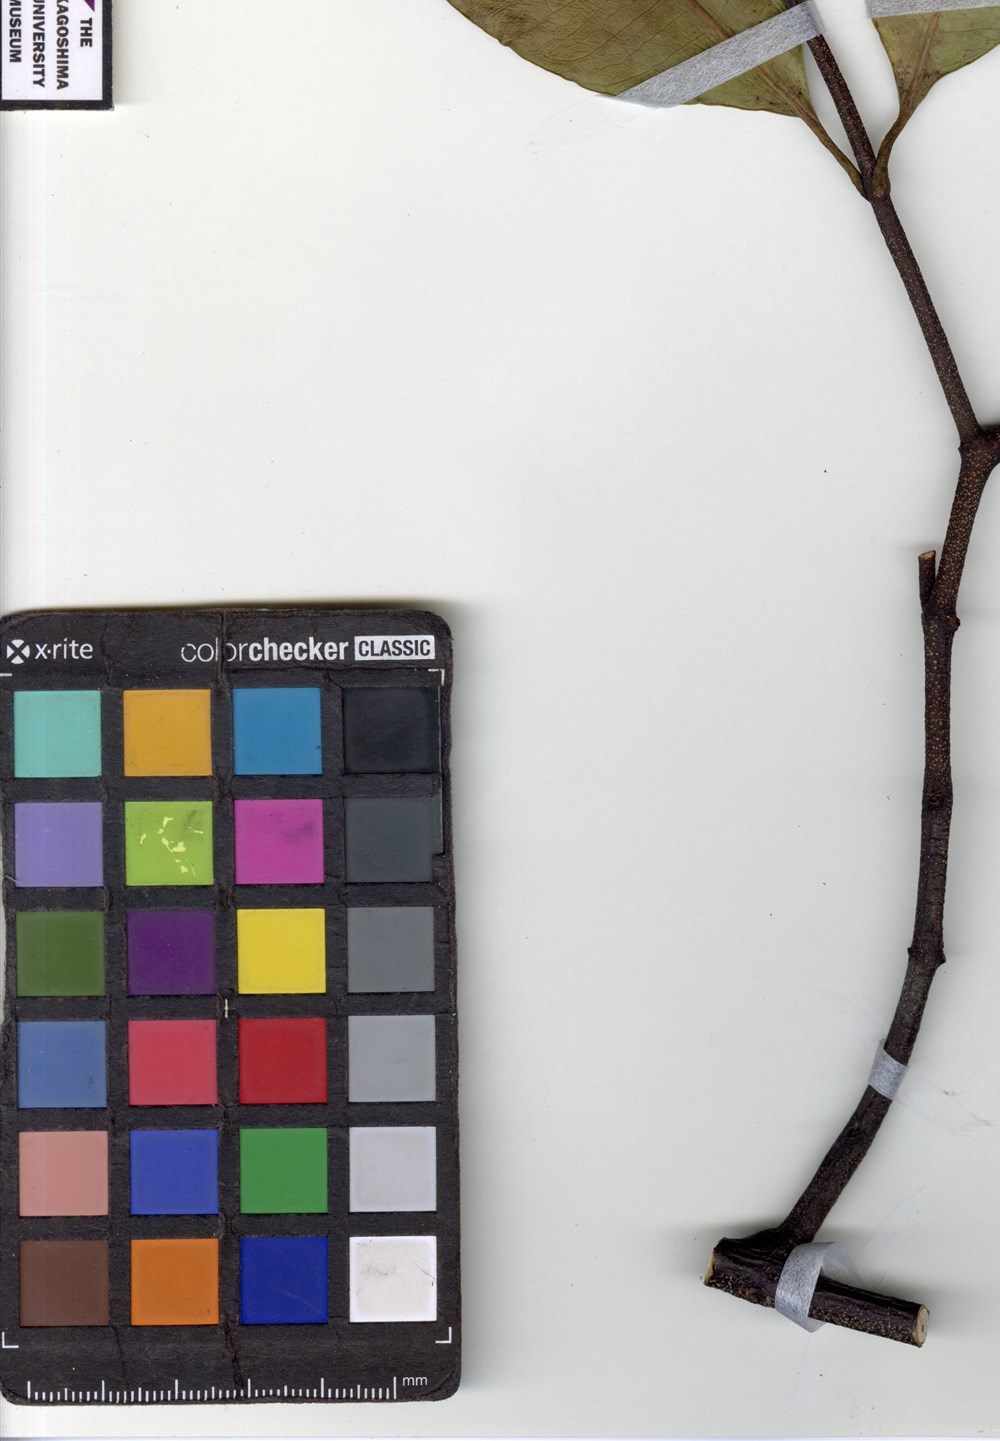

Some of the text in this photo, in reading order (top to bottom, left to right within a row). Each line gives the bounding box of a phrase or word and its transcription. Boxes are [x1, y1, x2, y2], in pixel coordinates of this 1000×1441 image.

[79, 17, 93, 48] THE
[358, 638, 430, 657] CLASSIC
[402, 1376, 428, 1386] mm
